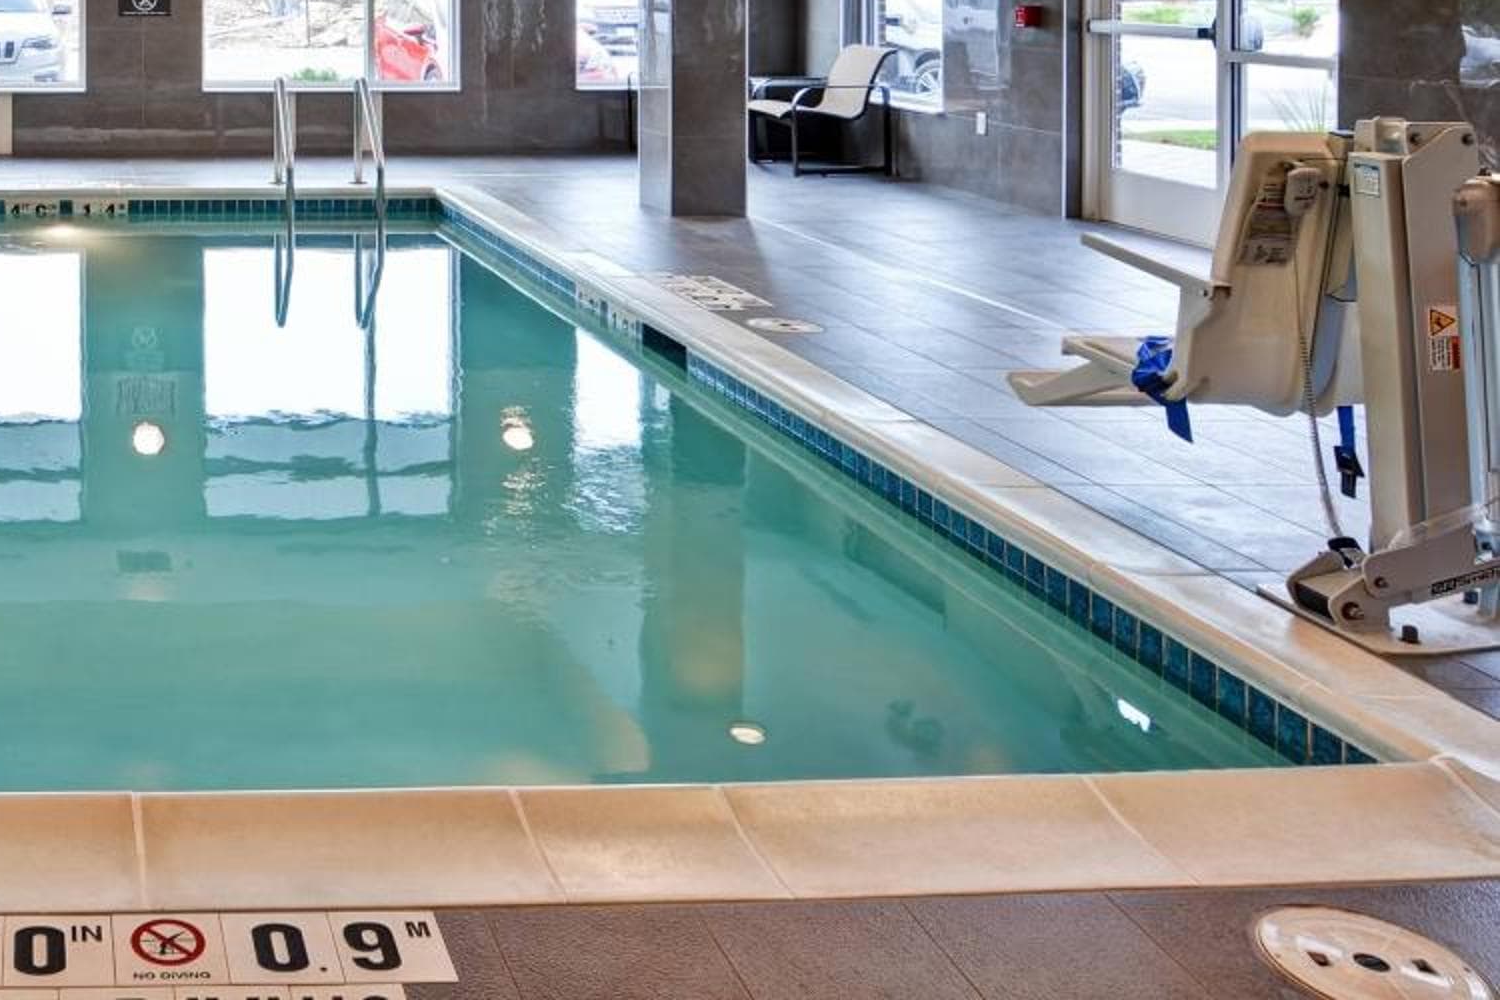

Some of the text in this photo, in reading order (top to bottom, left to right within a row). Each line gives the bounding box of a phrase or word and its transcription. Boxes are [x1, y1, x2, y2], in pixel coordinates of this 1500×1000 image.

[405, 921, 432, 938] M
[13, 926, 67, 976] 0
[71, 925, 103, 943] IN
[133, 971, 211, 980] NO DIVING
